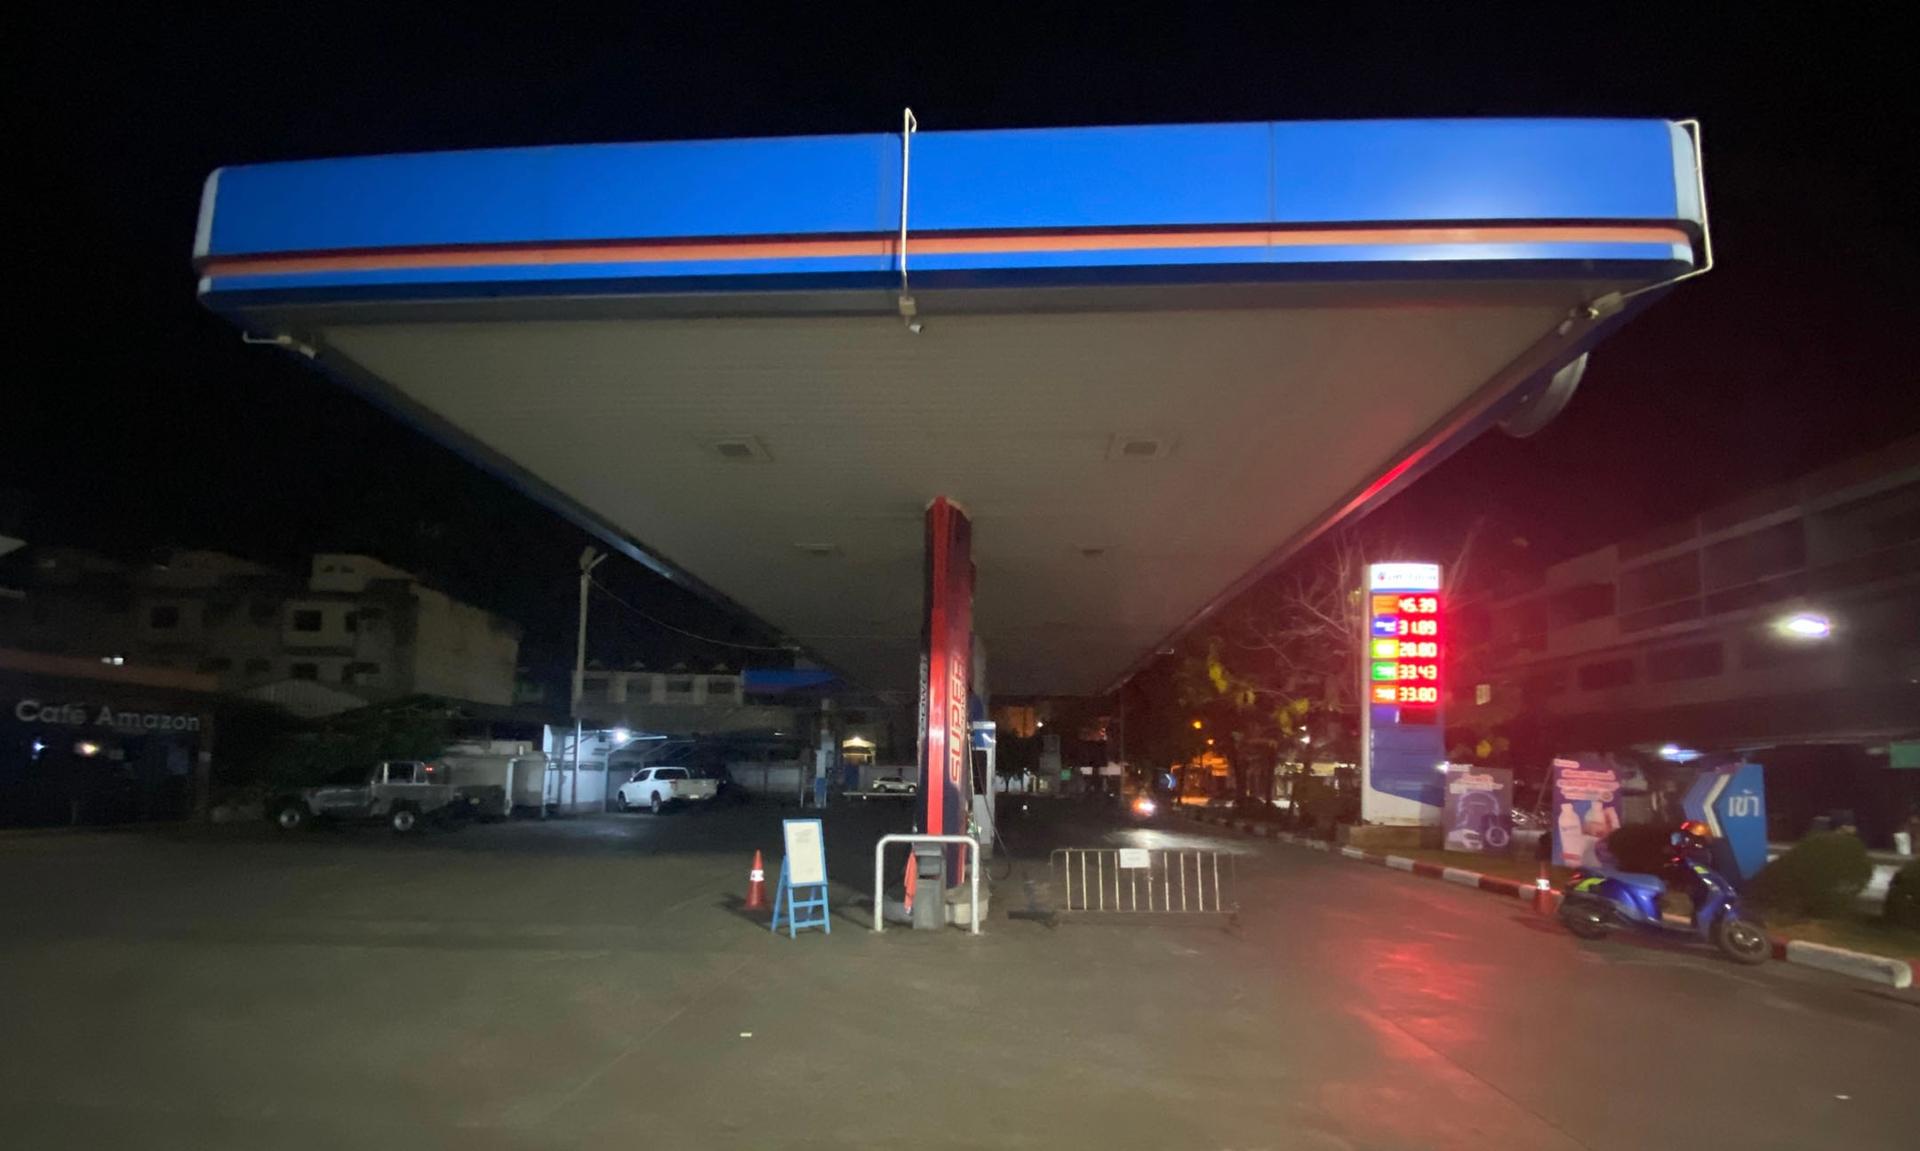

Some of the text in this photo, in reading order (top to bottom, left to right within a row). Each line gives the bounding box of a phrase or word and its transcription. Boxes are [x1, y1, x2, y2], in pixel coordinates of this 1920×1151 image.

[1398, 664, 1437, 680] 33.43
[15, 699, 202, 731] Café Amazon
[950, 654, 964, 783] SUPER
[1728, 788, 1760, 818] เข้า
